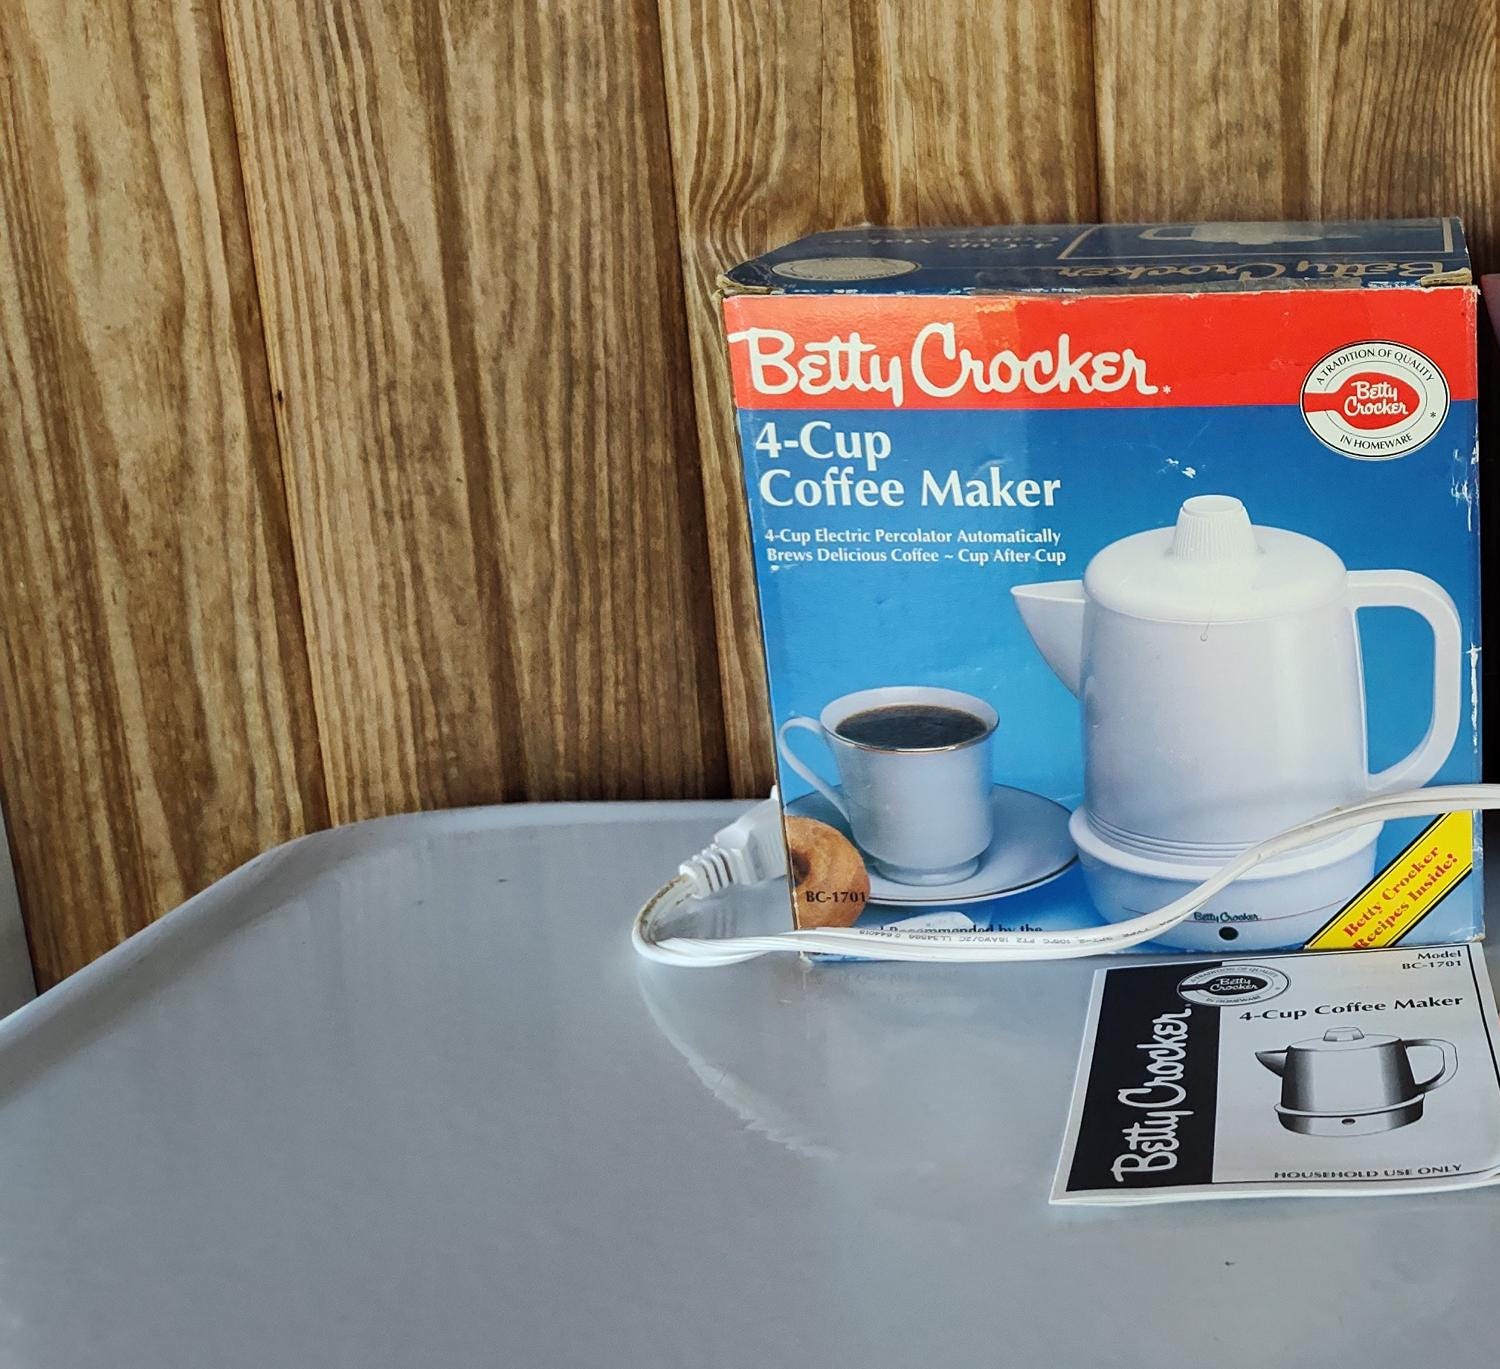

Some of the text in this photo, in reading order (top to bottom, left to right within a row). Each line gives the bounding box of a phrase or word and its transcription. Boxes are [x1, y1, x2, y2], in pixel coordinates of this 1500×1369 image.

[727, 327, 904, 407] Betty
[1316, 348, 1435, 385] A TRADITION OF QUALITY
[1351, 381, 1398, 401] Betty
[1344, 396, 1408, 417] Crocker
[755, 420, 892, 471] 4-Cup
[1340, 433, 1412, 449] IN HOMEWARE
[760, 466, 1061, 507] Coffee Maker
[765, 528, 1061, 546] 4-Cup Electric Percolator Automatically
[766, 548, 813, 562] Brews
[817, 548, 887, 562] Delicious
[891, 548, 939, 562] Coffee
[958, 548, 989, 566] Cup
[993, 548, 1030, 562] After
[1035, 548, 1066, 566] Cup
[806, 891, 865, 903] BC-1701
[1343, 846, 1439, 937] Betty Crocker
[1353, 853, 1459, 949] Recipes Inside!
[1194, 912, 1219, 923] Betty
[1220, 912, 1259, 922] Crocker
[1402, 960, 1461, 970] BC-1701
[1417, 950, 1461, 960] Model
[1239, 996, 1464, 1021] 4-Cup Coffee Maker
[1110, 1007, 1194, 1183] Betty Crocker
[1383, 1169, 1413, 1177] USE
[1417, 1163, 1462, 1175] ONLY
